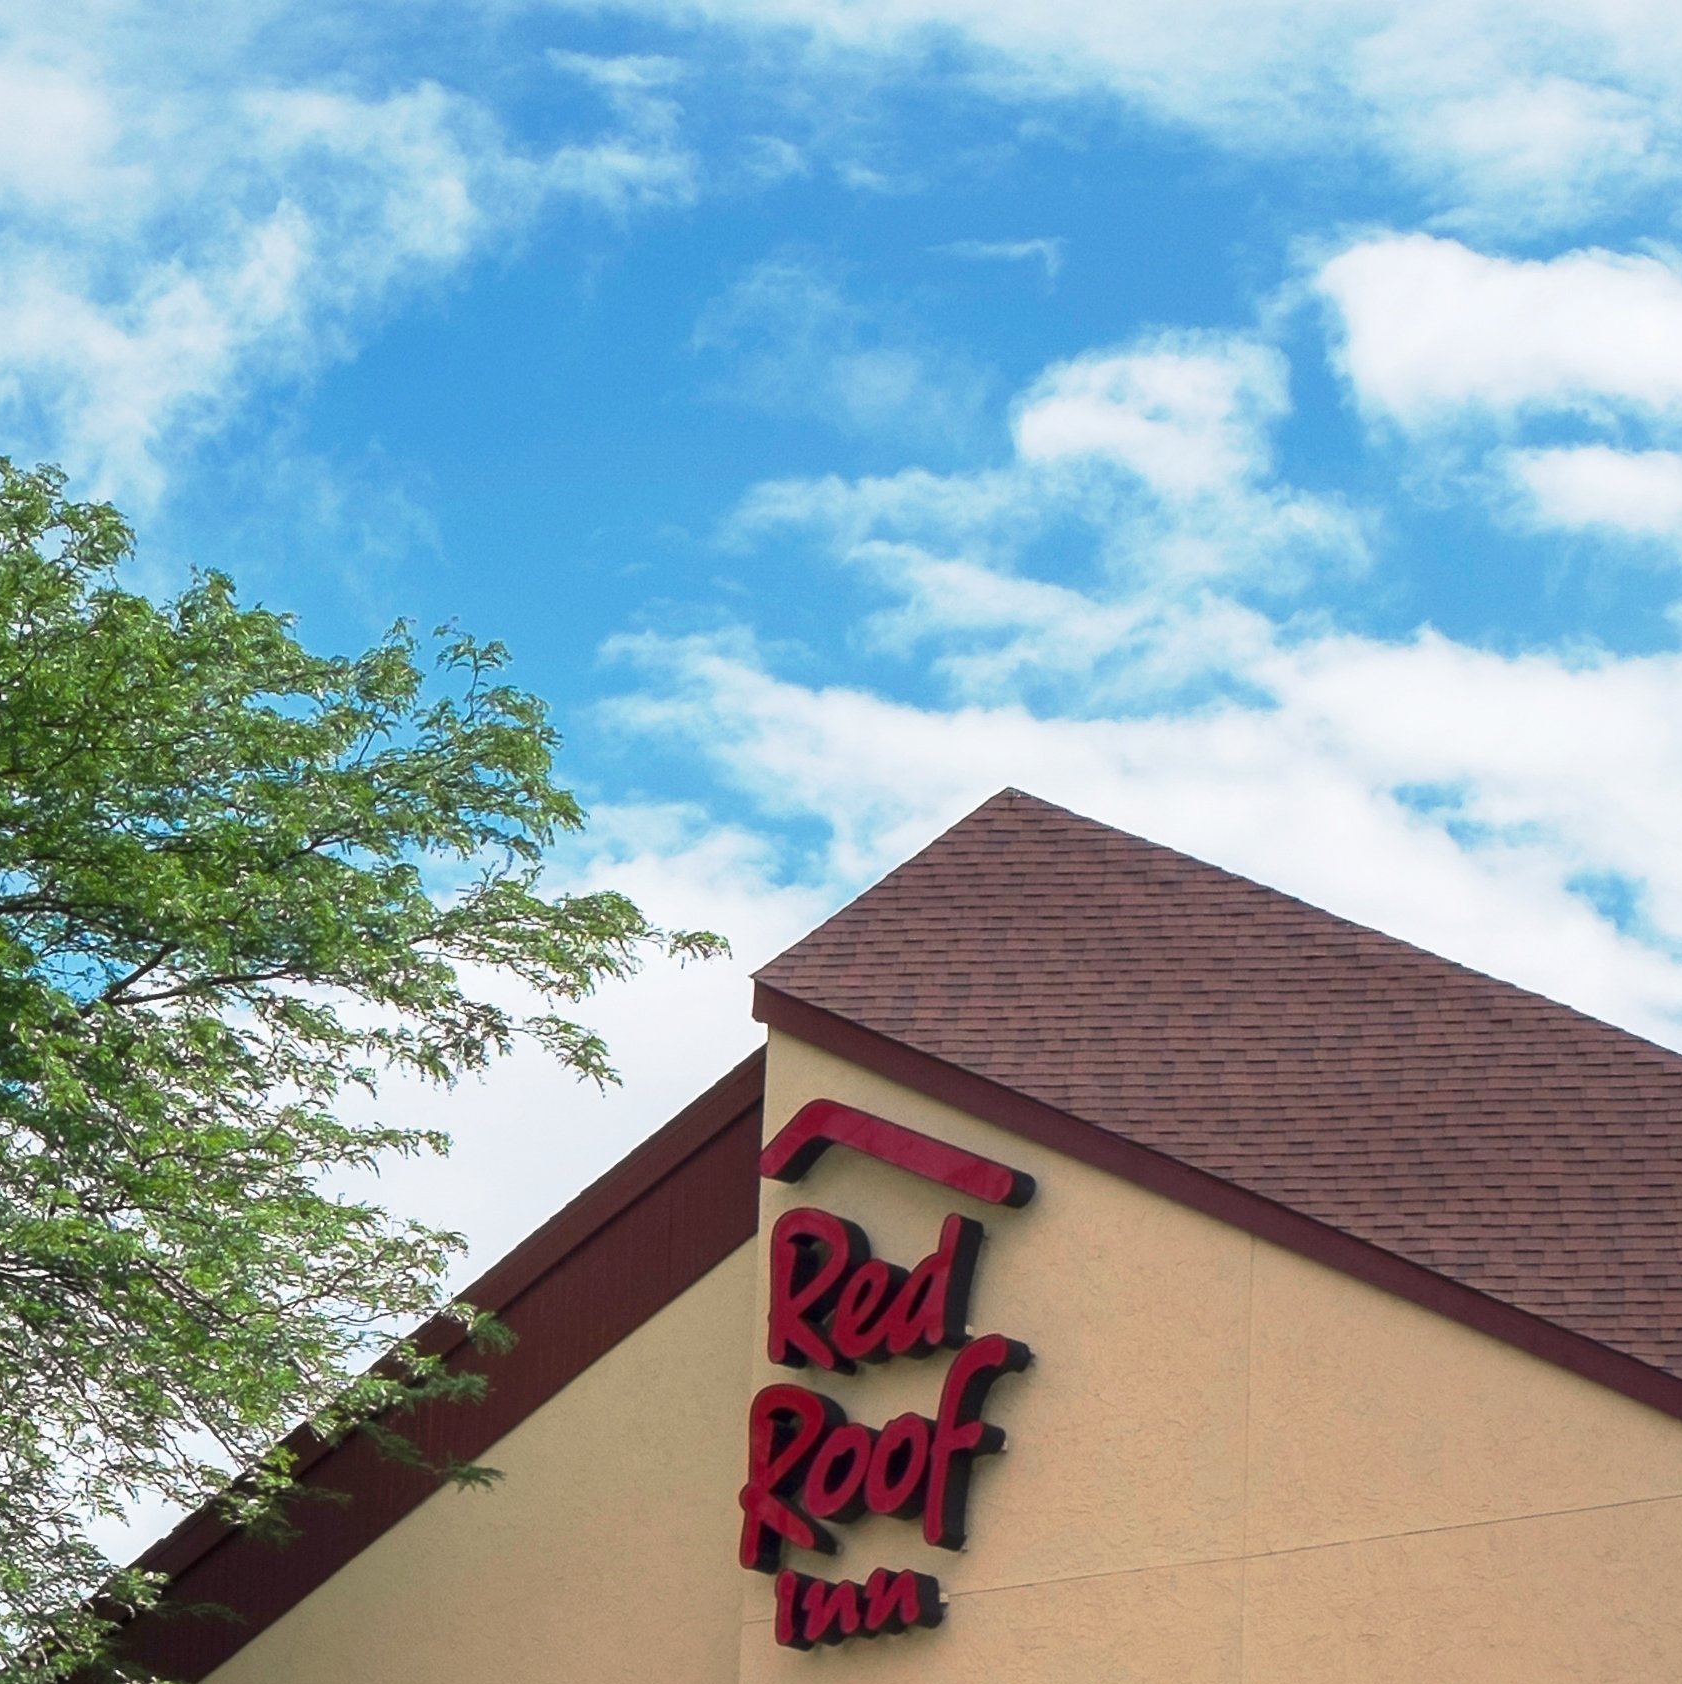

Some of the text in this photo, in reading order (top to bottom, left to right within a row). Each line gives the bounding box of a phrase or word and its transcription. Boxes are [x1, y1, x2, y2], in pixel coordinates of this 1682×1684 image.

[768, 1206, 984, 1375] Red
[739, 1333, 1031, 1572] Roof
[775, 1567, 942, 1650] Inn
